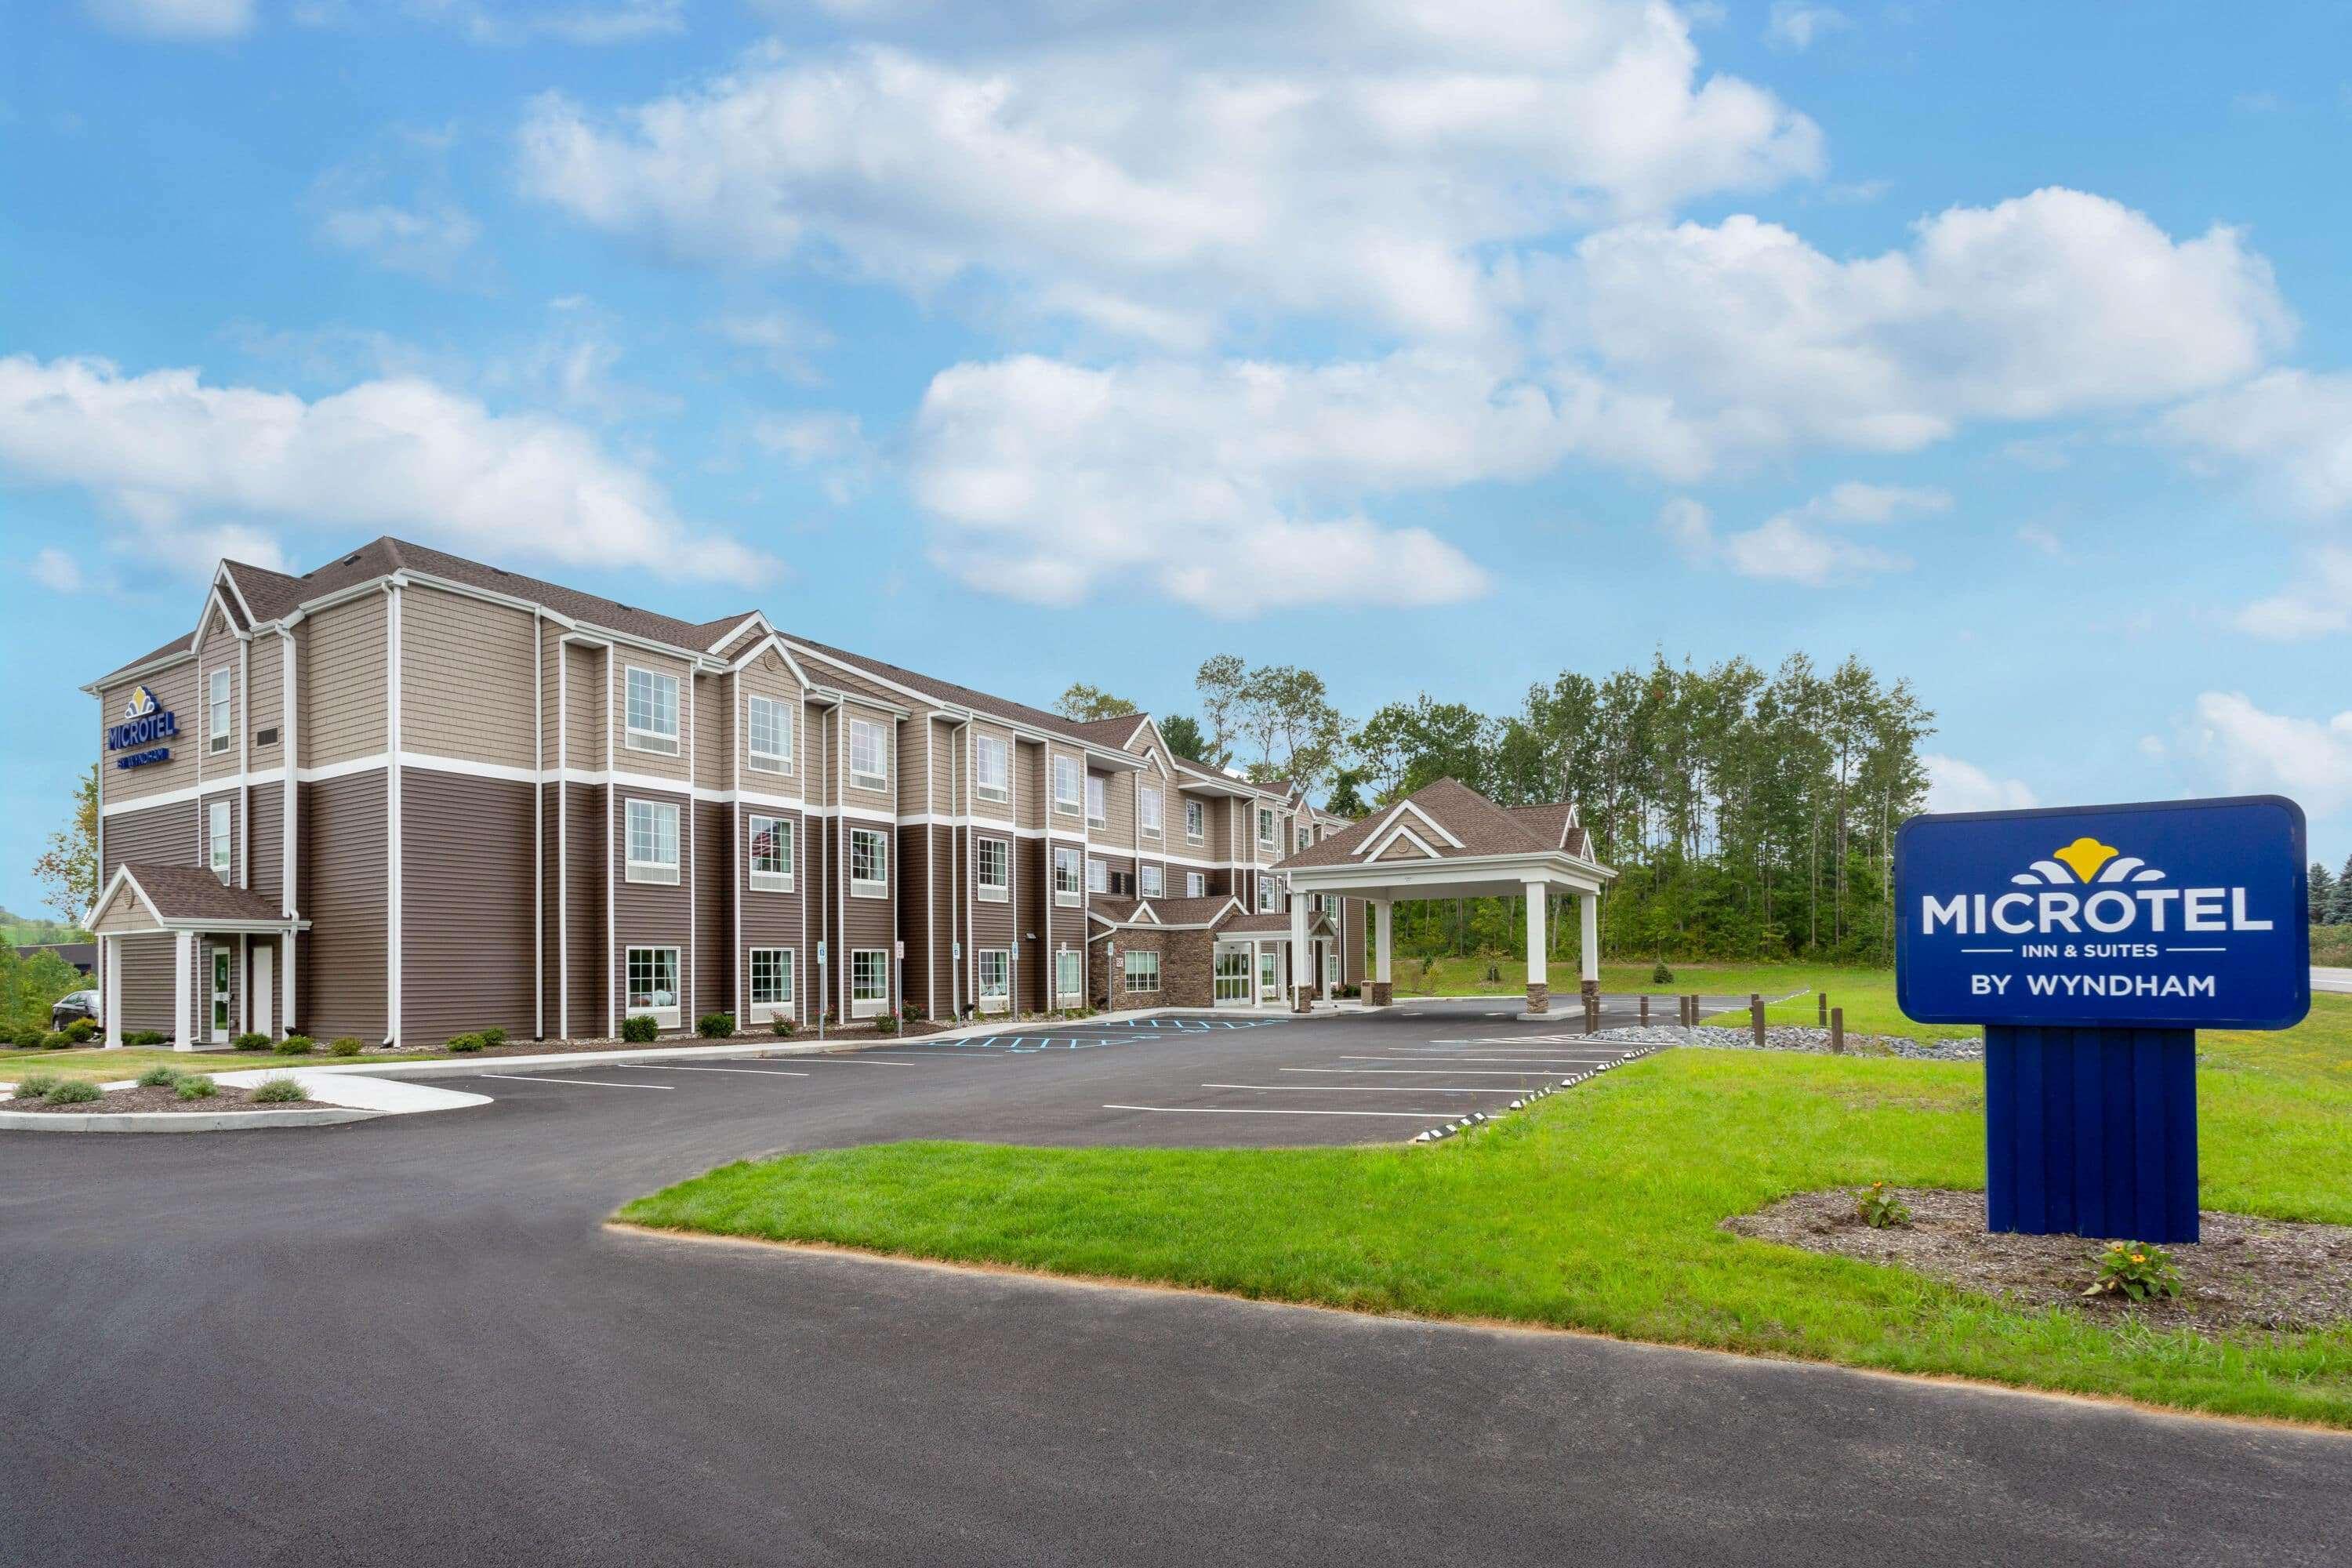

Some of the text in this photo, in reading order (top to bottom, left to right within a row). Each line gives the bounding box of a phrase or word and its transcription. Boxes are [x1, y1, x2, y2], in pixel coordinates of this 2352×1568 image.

[108, 711, 174, 750] MICROTEL
[1922, 887, 2273, 935] MICROTEL
[2022, 944, 2158, 957] INN & SUITES
[1972, 975, 2216, 997] BY WYNDHAM
